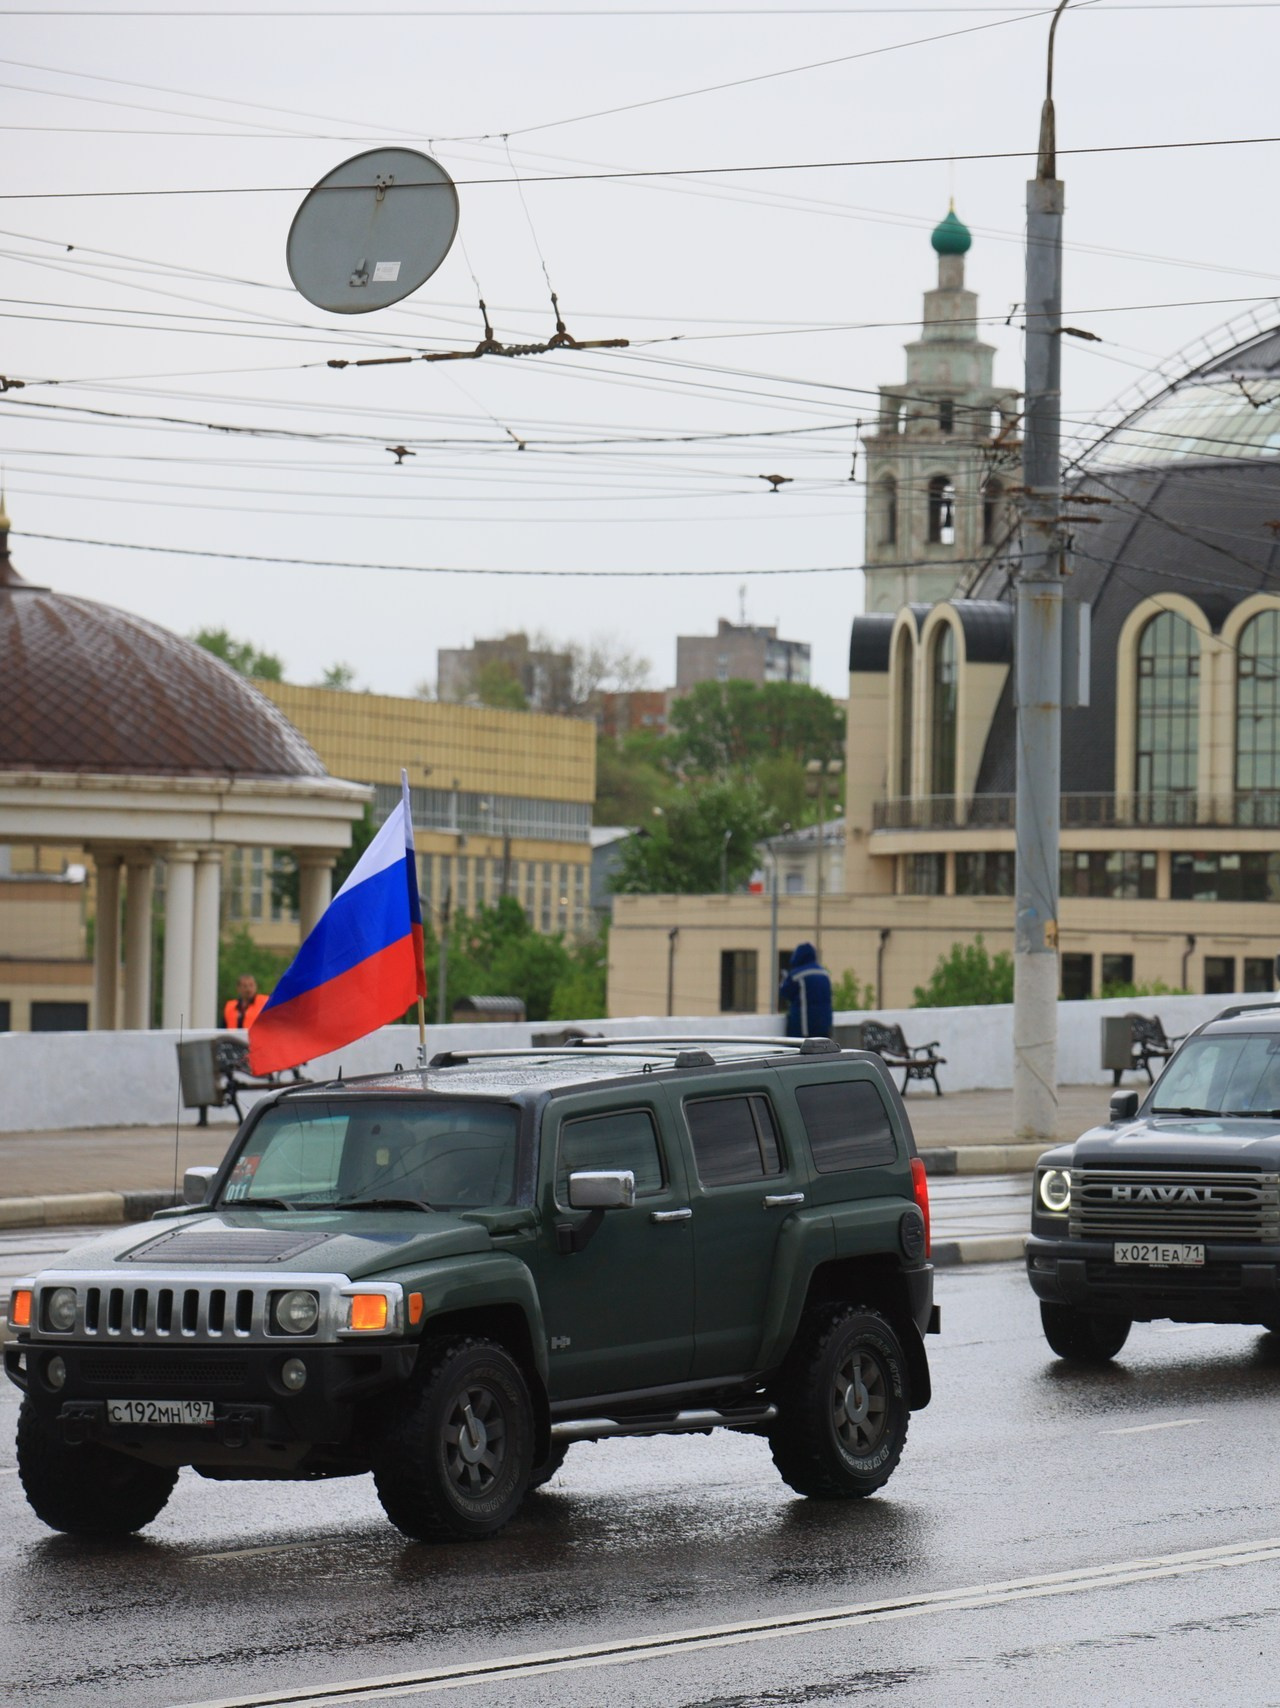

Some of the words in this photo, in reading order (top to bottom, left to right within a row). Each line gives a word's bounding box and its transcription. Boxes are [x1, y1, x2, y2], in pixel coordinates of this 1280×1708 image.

[1111, 1186, 1223, 1203] HAVAL
[1120, 1245, 1180, 1262] Х021ЕА
[1184, 1245, 1200, 1258] 71
[112, 1401, 182, 1423] С192МН
[184, 1401, 212, 1418] 197
